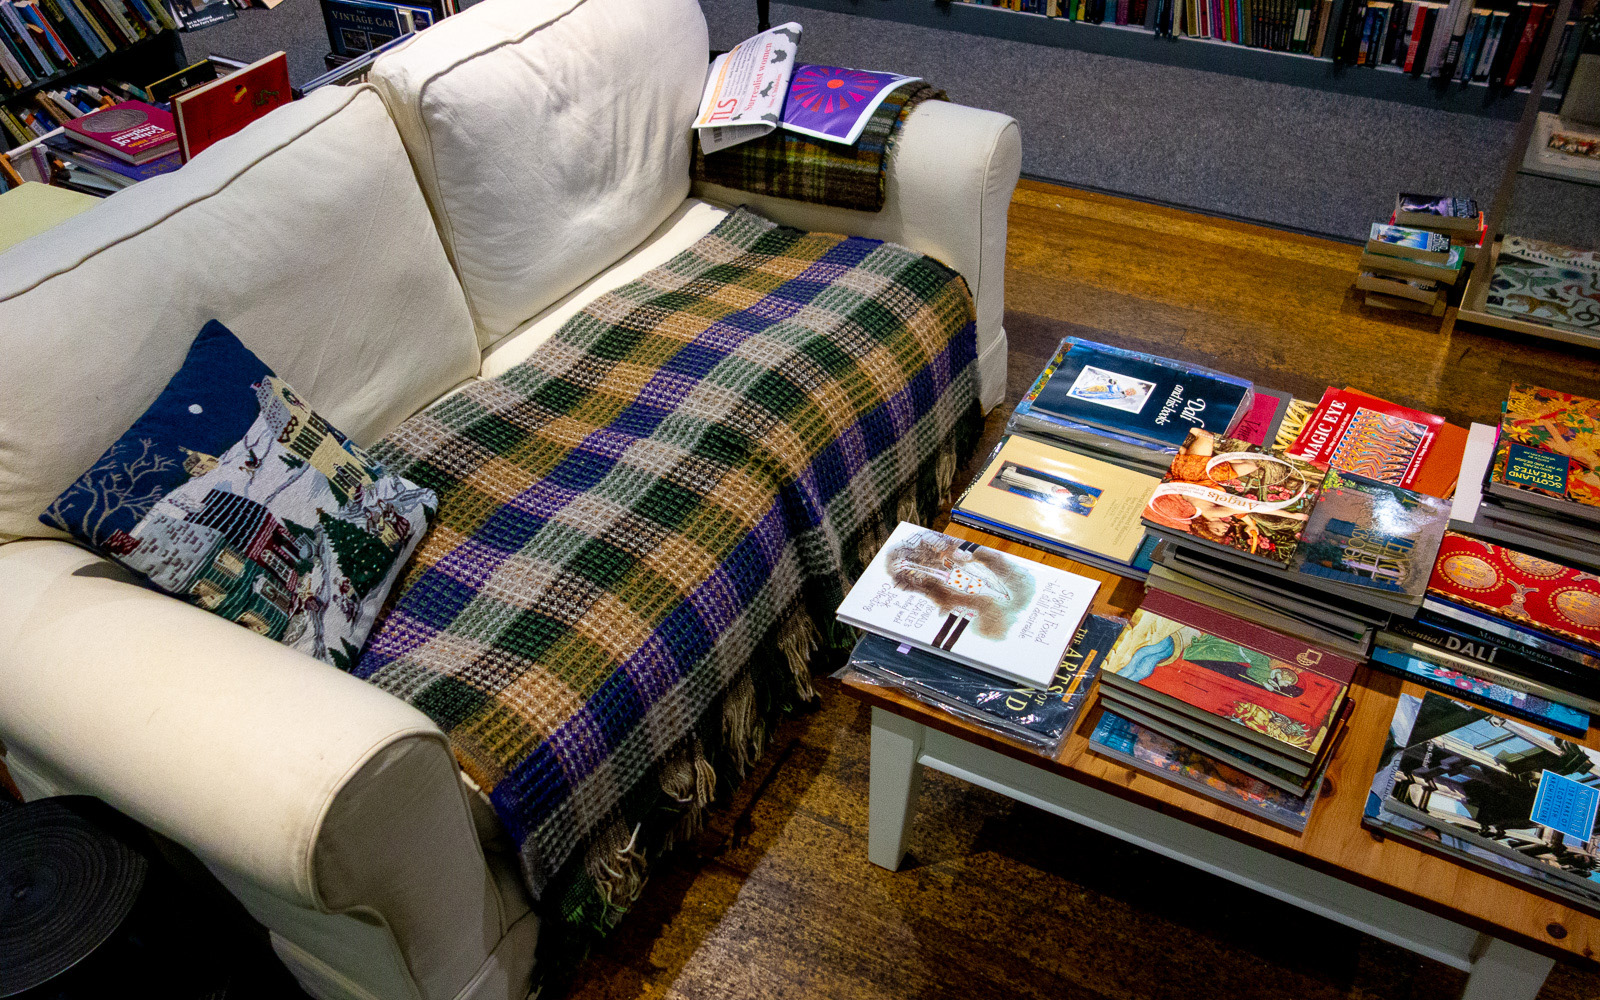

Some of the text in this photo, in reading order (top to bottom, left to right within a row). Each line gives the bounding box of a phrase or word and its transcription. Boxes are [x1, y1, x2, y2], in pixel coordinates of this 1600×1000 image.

[332, 10, 395, 28] VINTAGE CAR
[744, 42, 772, 111] Surrealist women
[708, 98, 738, 123] TLS
[111, 126, 153, 143] England
[131, 125, 165, 140] Coins
[1155, 385, 1184, 425] and his books
[1301, 400, 1346, 460] MAGIC EYE
[1508, 471, 1562, 488] SCOTLAND
[1514, 465, 1562, 482] CREATES
[1208, 491, 1260, 510] Angels
[914, 605, 936, 628] RONALD
[1035, 589, 1074, 646] Slightly Foxed
[1074, 628, 1088, 645] THE
[1395, 624, 1498, 663] Essential DALÍ
[1048, 648, 1083, 694] ARTS
[1450, 661, 1492, 679] AMERICAN
[1492, 674, 1532, 692] PAINTING
[1431, 680, 1457, 693] ANIMALS
[1034, 693, 1048, 706] OF
[1540, 775, 1557, 823] ARCHITECTURE
[1552, 787, 1564, 818] SCOTTISH
[1564, 797, 1572, 817] YEARS
